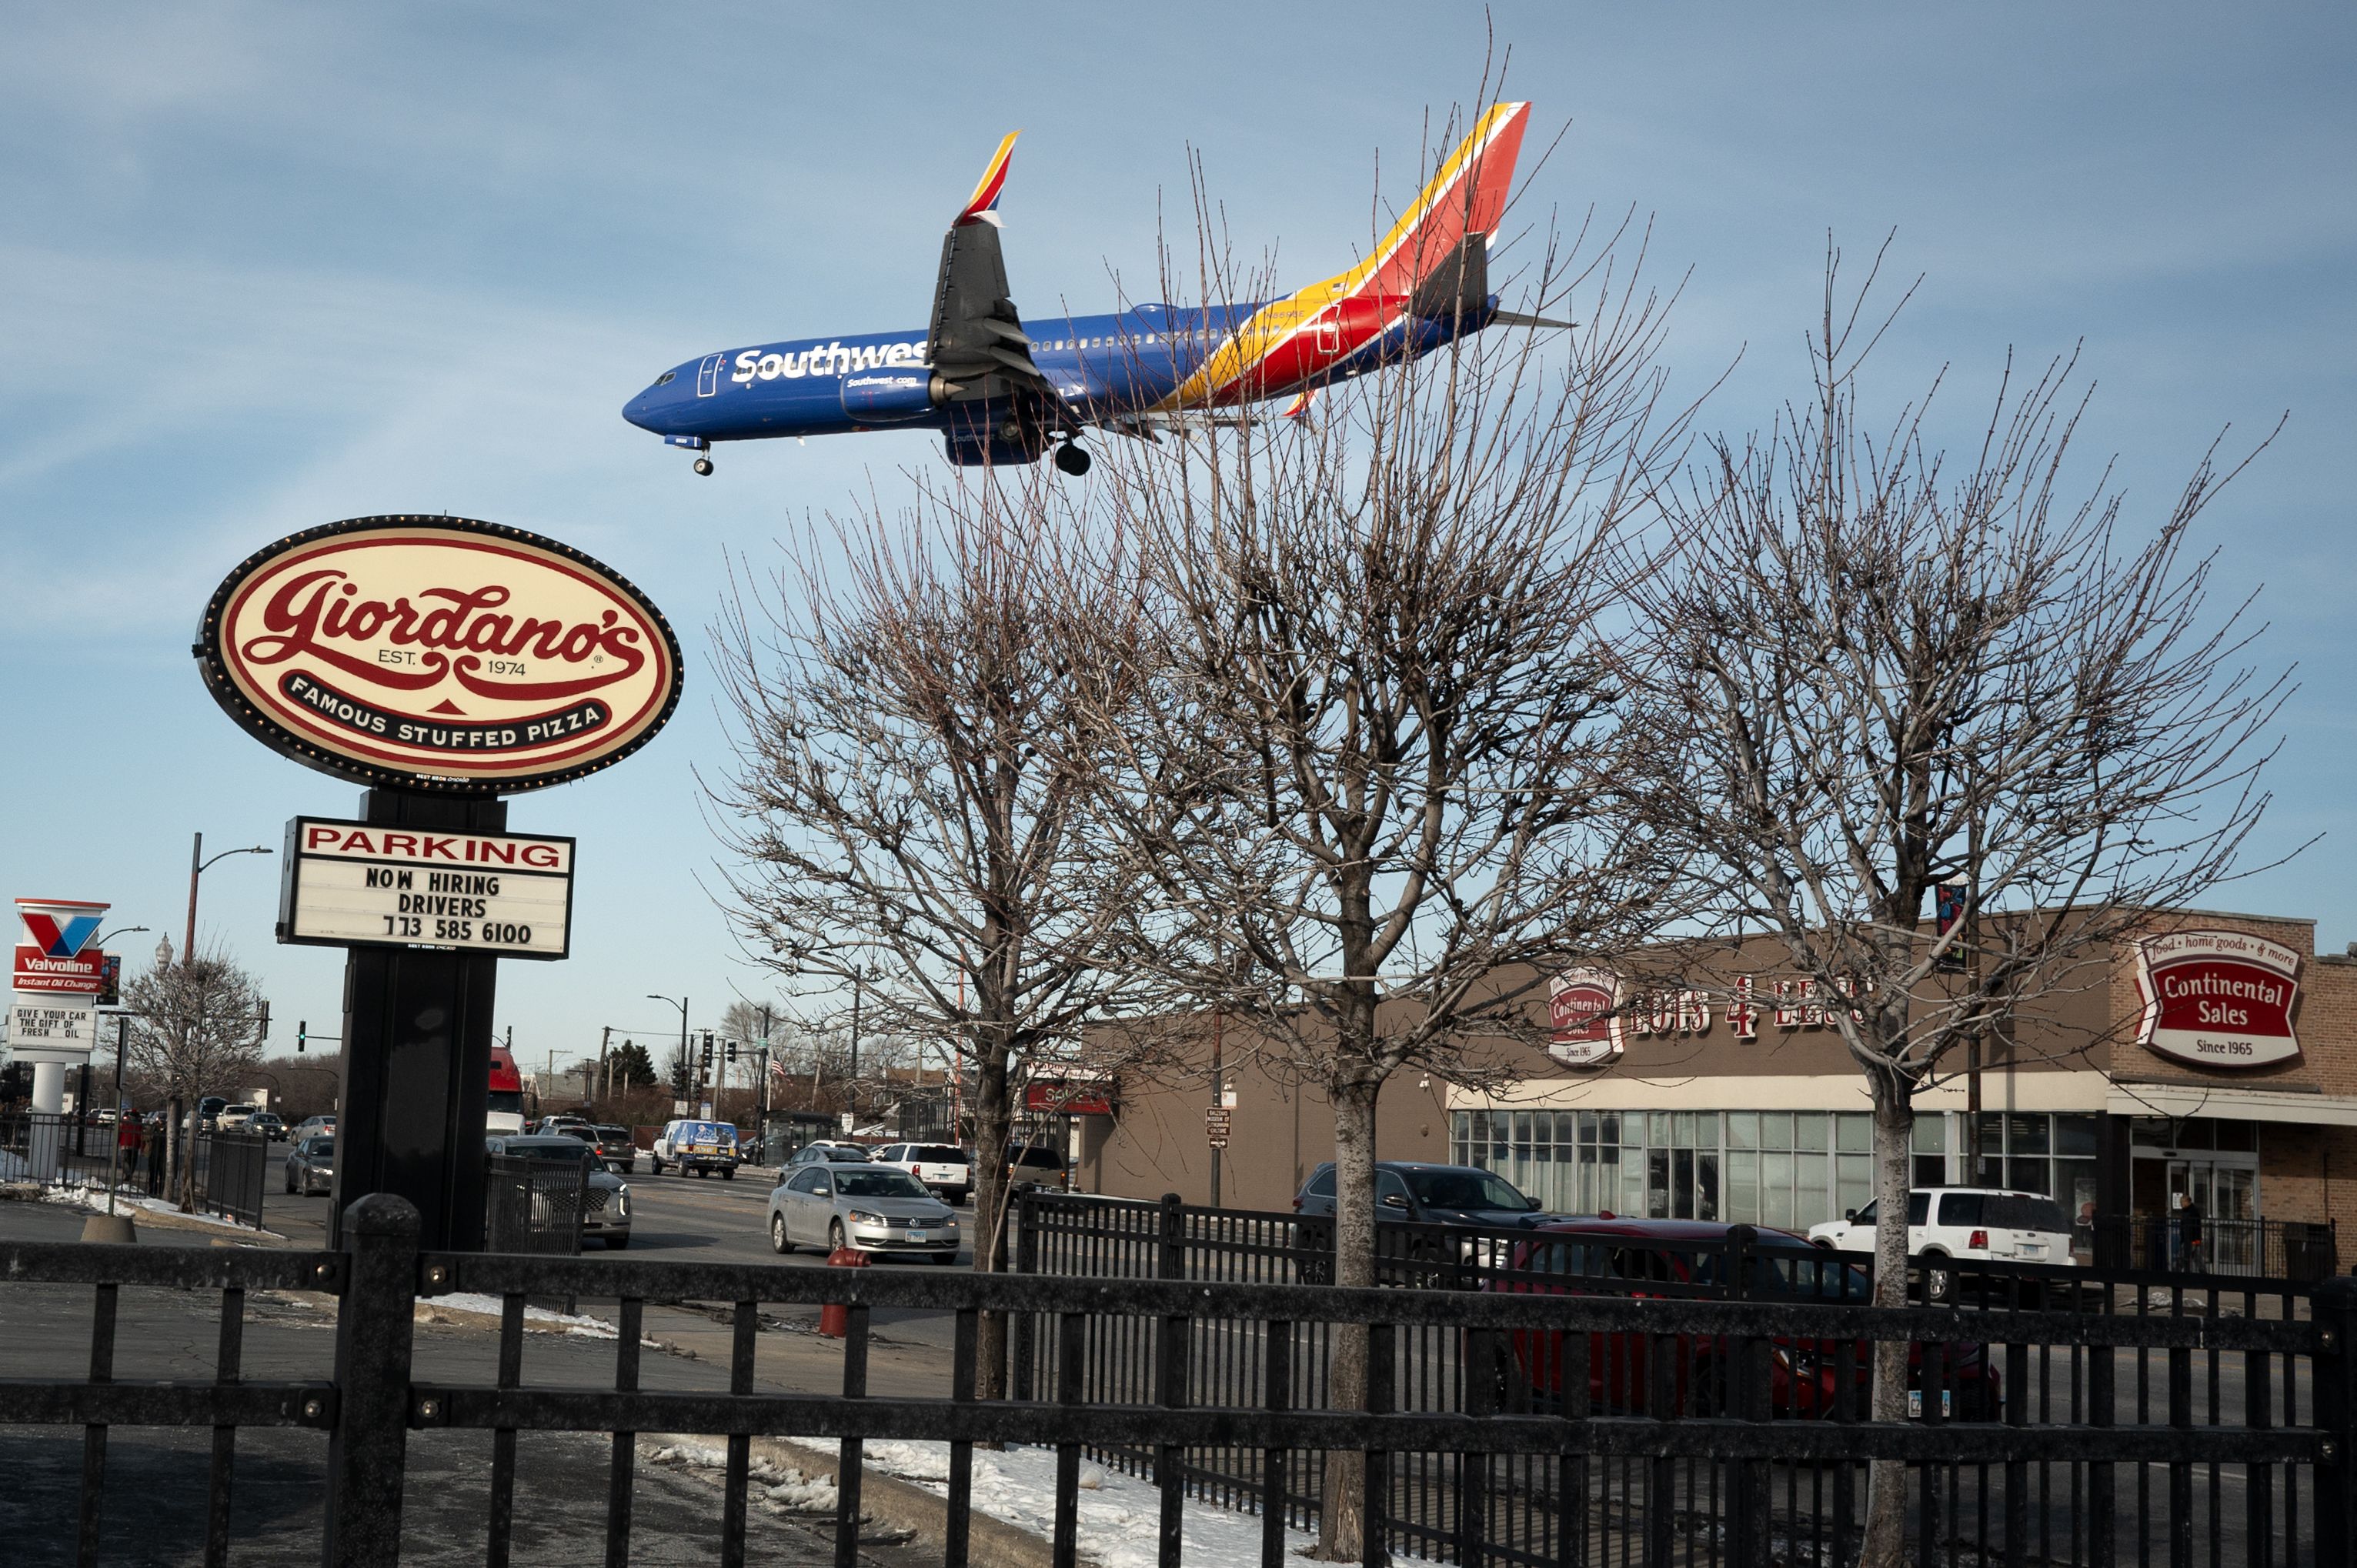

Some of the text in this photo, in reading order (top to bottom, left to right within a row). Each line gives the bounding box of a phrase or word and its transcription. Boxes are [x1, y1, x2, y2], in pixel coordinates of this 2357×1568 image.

[731, 341, 928, 383] Southwes
[242, 570, 644, 701] Giordano's
[379, 649, 526, 676] EST. 1974
[291, 677, 600, 748] FAMOUS STUFFED PIZZA
[308, 828, 559, 868] PARKING
[366, 867, 499, 896] NOW HIRING
[399, 894, 486, 919] DRIVERS
[383, 916, 532, 944] 773 585 6100
[2152, 936, 2295, 967] food home goods & more
[25, 957, 93, 974] Valvoline
[18, 977, 98, 990] Instant Oil Change
[2165, 972, 2284, 1007] Continental
[18, 1009, 87, 1021] GIVE YOUR CAR
[1724, 974, 1756, 1039] 4
[2198, 999, 2248, 1026] Sales
[20, 1018, 74, 1029] THE GIFT OF
[22, 1028, 79, 1039] FRESH OIL
[2197, 1039, 2253, 1056] Since 1965
